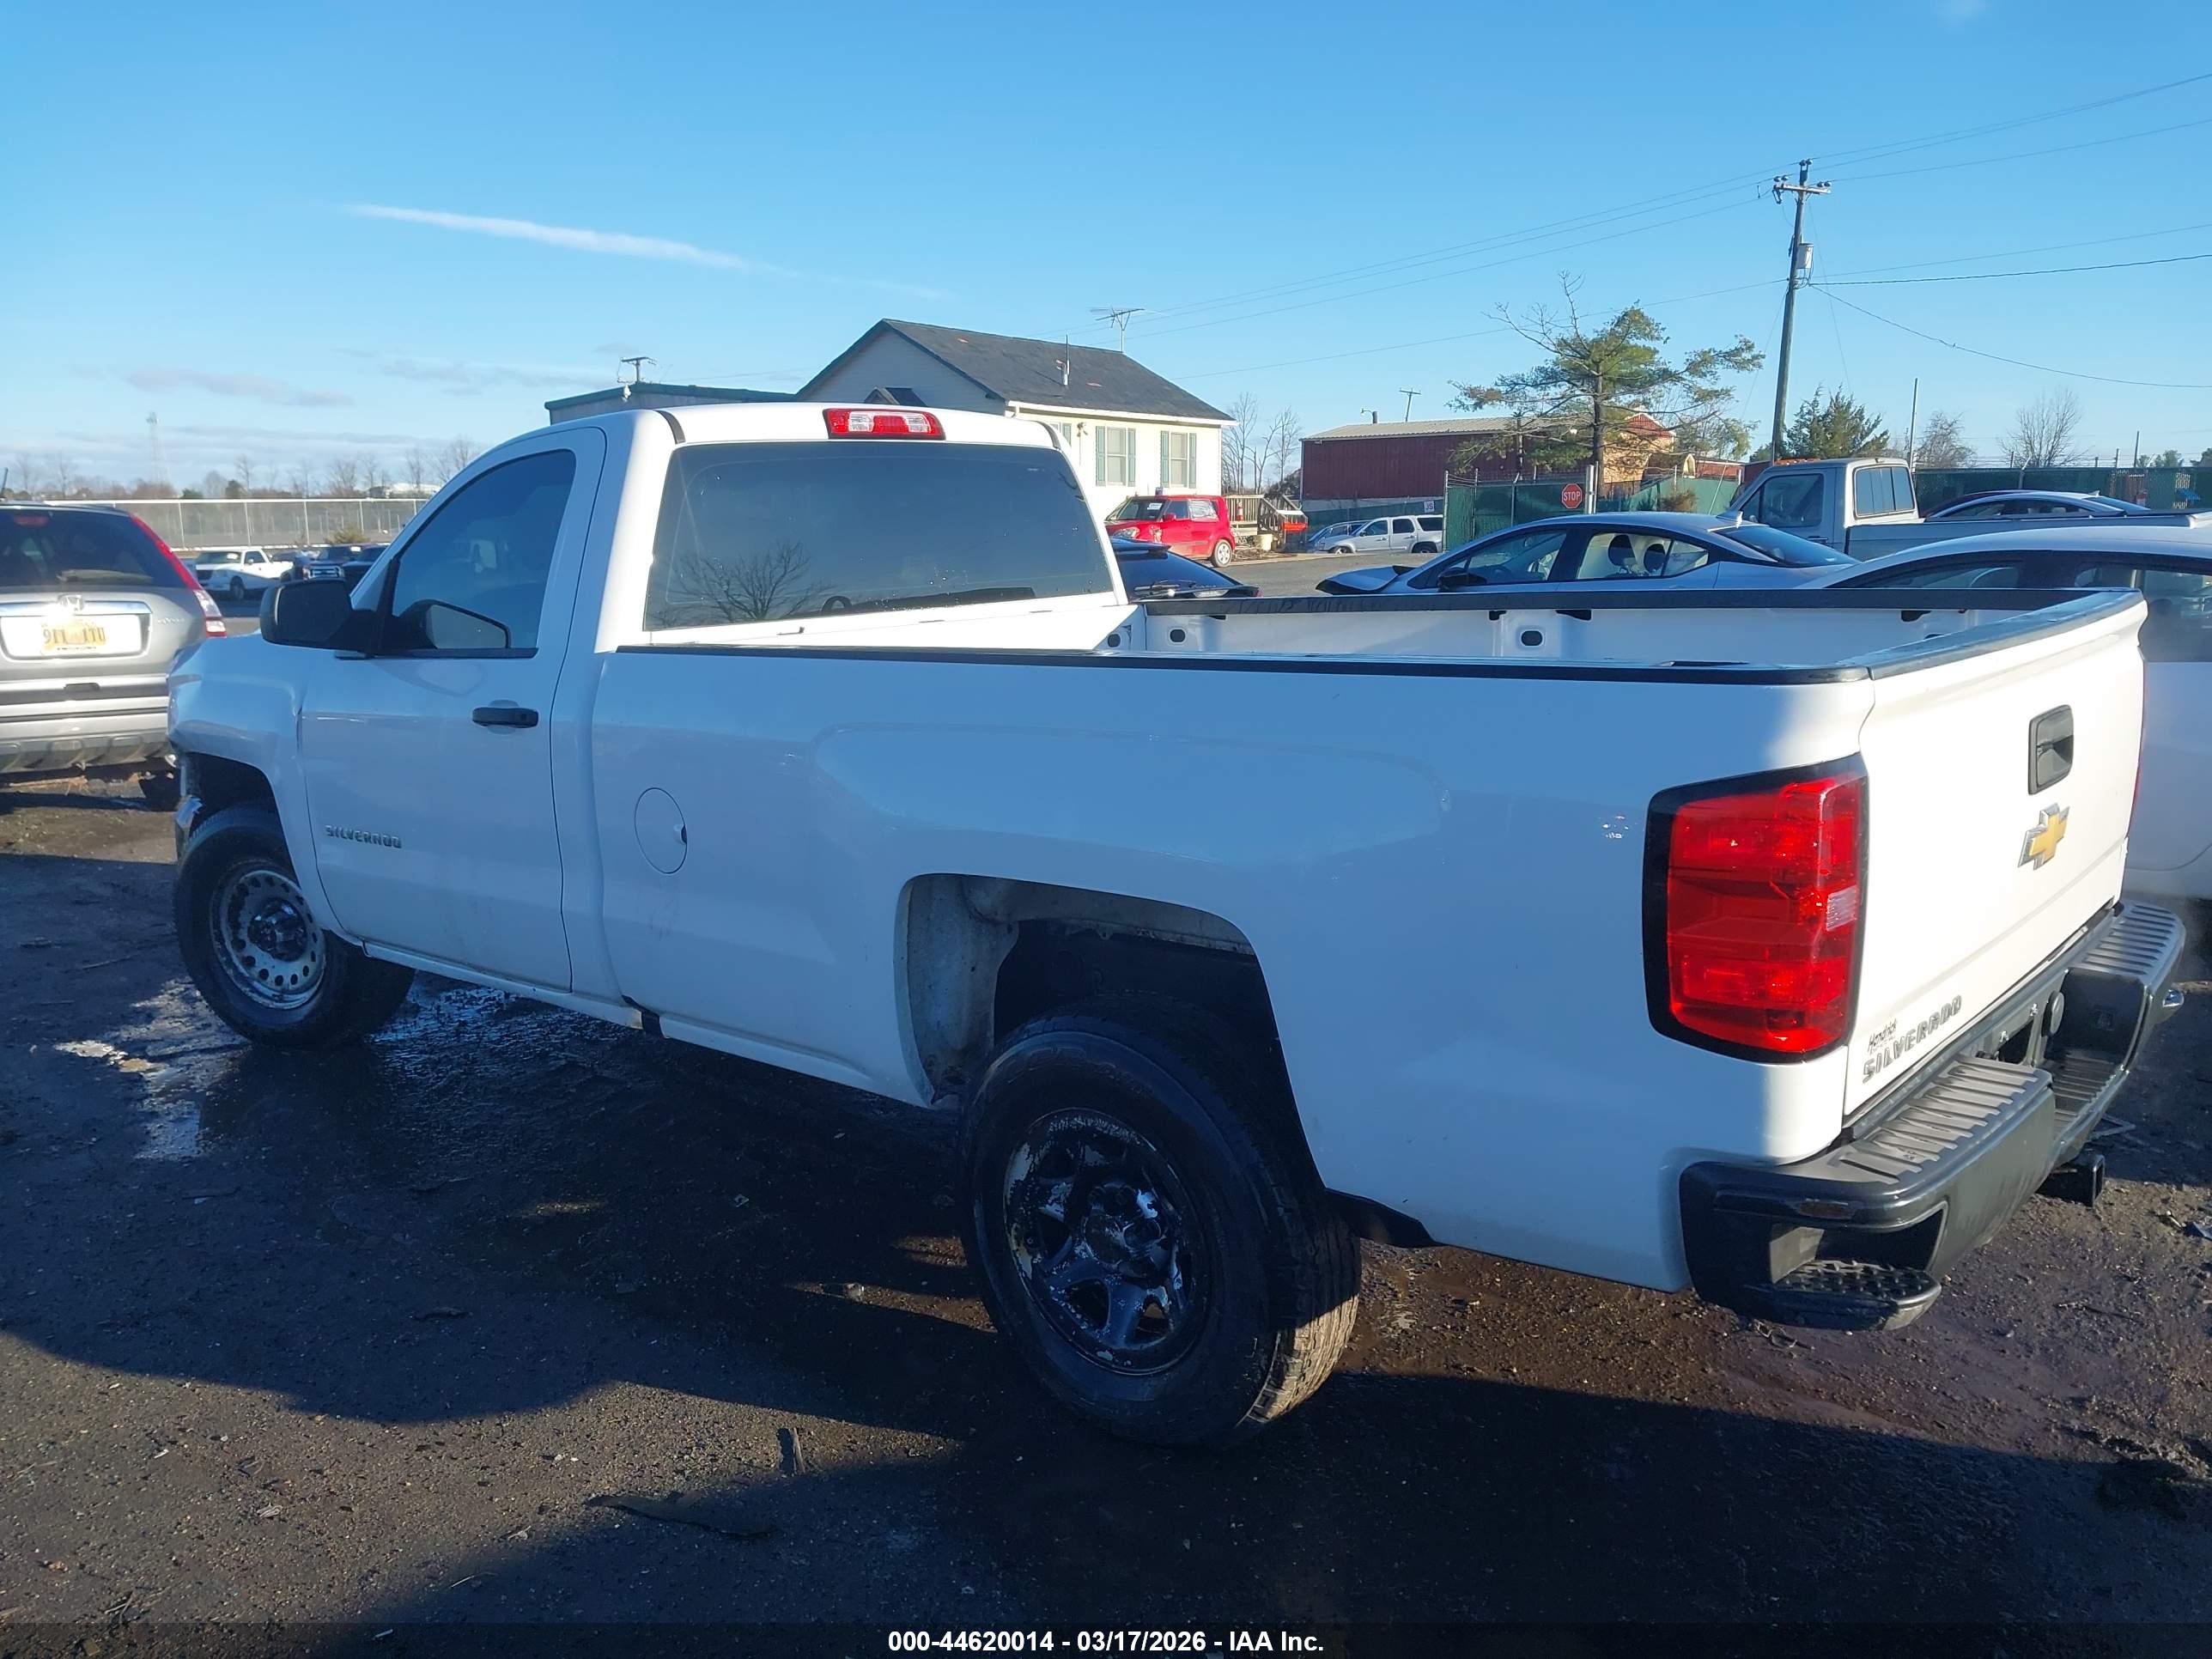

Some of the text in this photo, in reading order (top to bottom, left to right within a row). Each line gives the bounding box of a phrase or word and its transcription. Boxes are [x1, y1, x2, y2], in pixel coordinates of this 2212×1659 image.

[1564, 491, 1581, 501] STOP
[325, 824, 402, 848] SILVERADO
[1863, 995, 1962, 1084] SILVERADO
